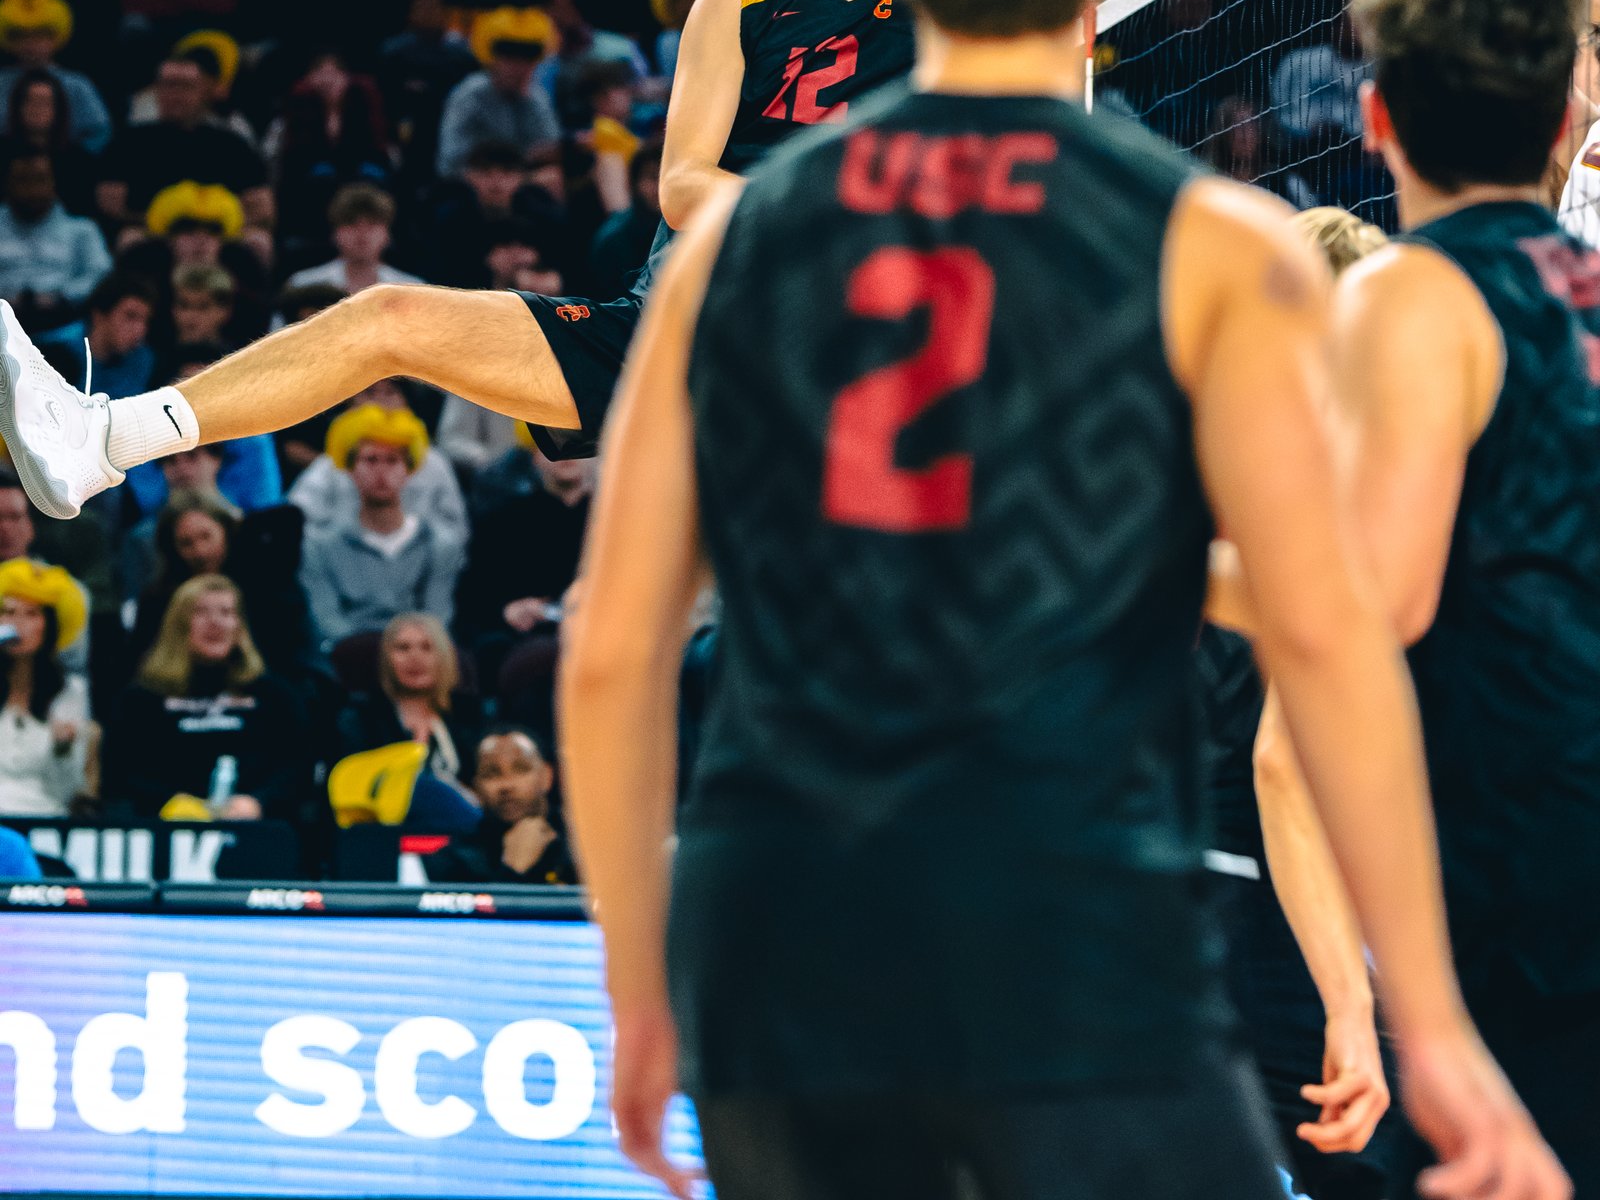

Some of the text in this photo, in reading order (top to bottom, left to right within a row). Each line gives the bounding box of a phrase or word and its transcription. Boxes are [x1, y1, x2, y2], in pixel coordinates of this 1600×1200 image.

[761, 34, 859, 124] 12
[823, 246, 996, 531] 2
[256, 1016, 597, 1140] sco
